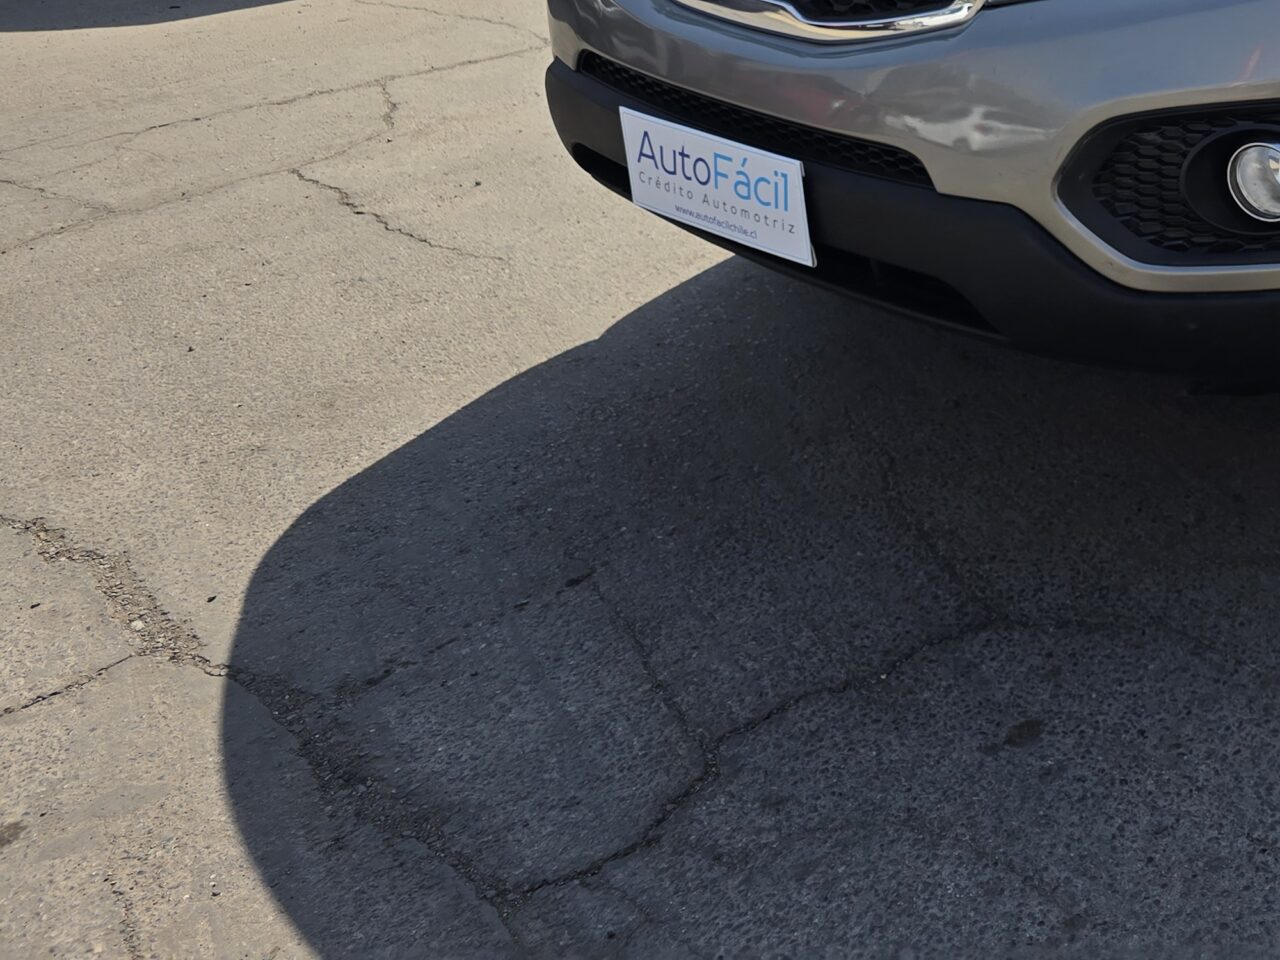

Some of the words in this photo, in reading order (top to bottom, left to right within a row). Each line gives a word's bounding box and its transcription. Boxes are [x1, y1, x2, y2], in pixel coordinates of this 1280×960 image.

[637, 130, 789, 212] AutoFácil
[639, 171, 694, 200] Crédito
[702, 193, 796, 234] Automotriz
